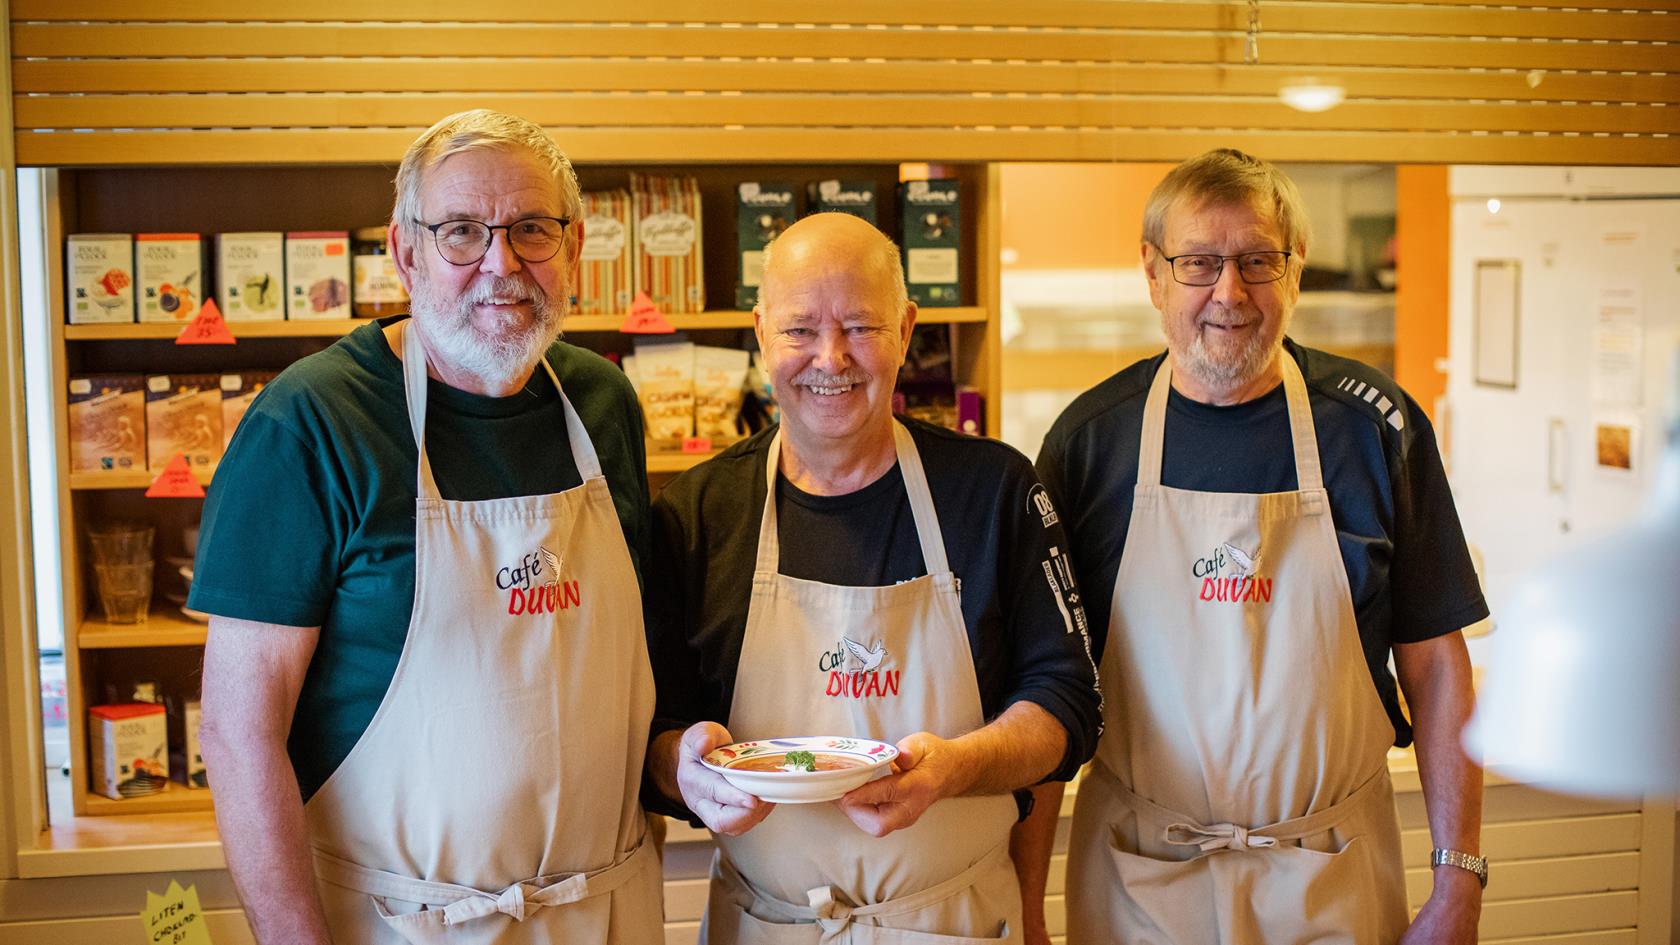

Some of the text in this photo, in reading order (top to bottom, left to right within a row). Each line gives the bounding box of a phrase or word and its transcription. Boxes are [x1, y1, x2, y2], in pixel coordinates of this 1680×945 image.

[1034, 490, 1054, 516] 08
[495, 551, 543, 592] Café
[1192, 546, 1226, 581] Café
[1199, 576, 1273, 603] DUVAN
[151, 899, 184, 927] LITEN
